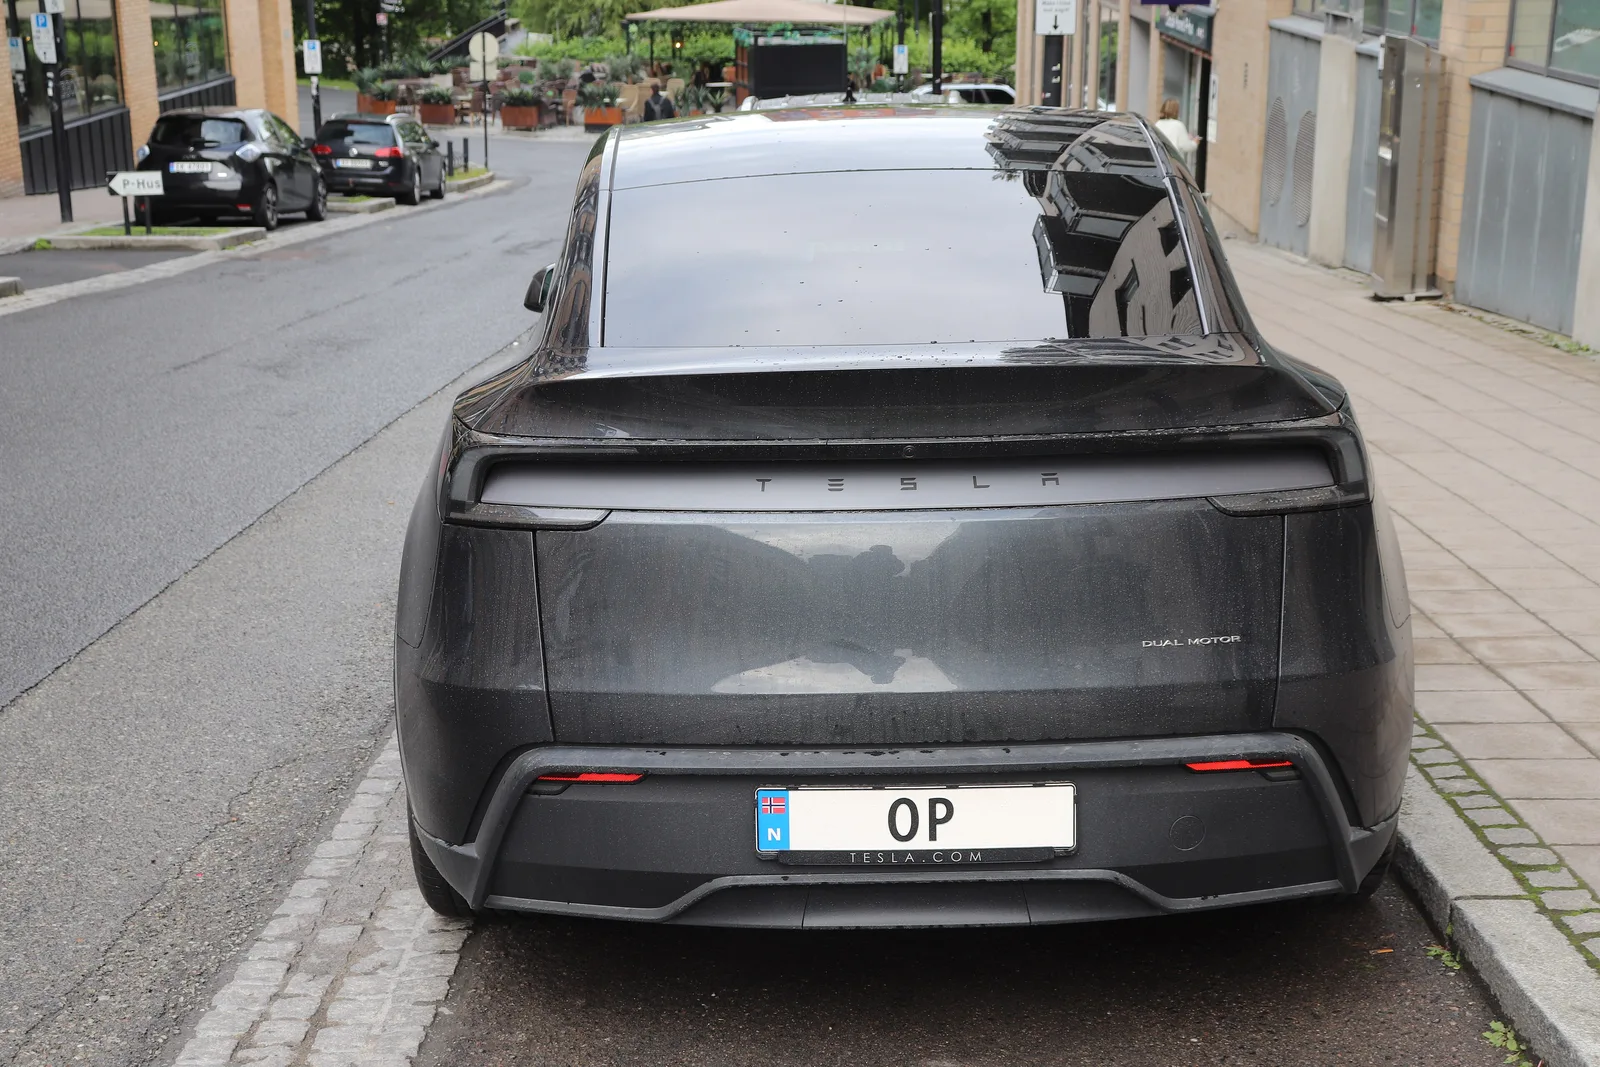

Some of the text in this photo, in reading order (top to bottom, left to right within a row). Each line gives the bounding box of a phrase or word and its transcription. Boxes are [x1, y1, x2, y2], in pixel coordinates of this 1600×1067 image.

[122, 178, 161, 189] P-Hus
[755, 472, 1059, 492] TESLA
[1142, 635, 1241, 648] DUAL MOTOR
[888, 797, 954, 842] OP
[767, 827, 781, 841] N
[849, 851, 982, 863] TESLA.COM
